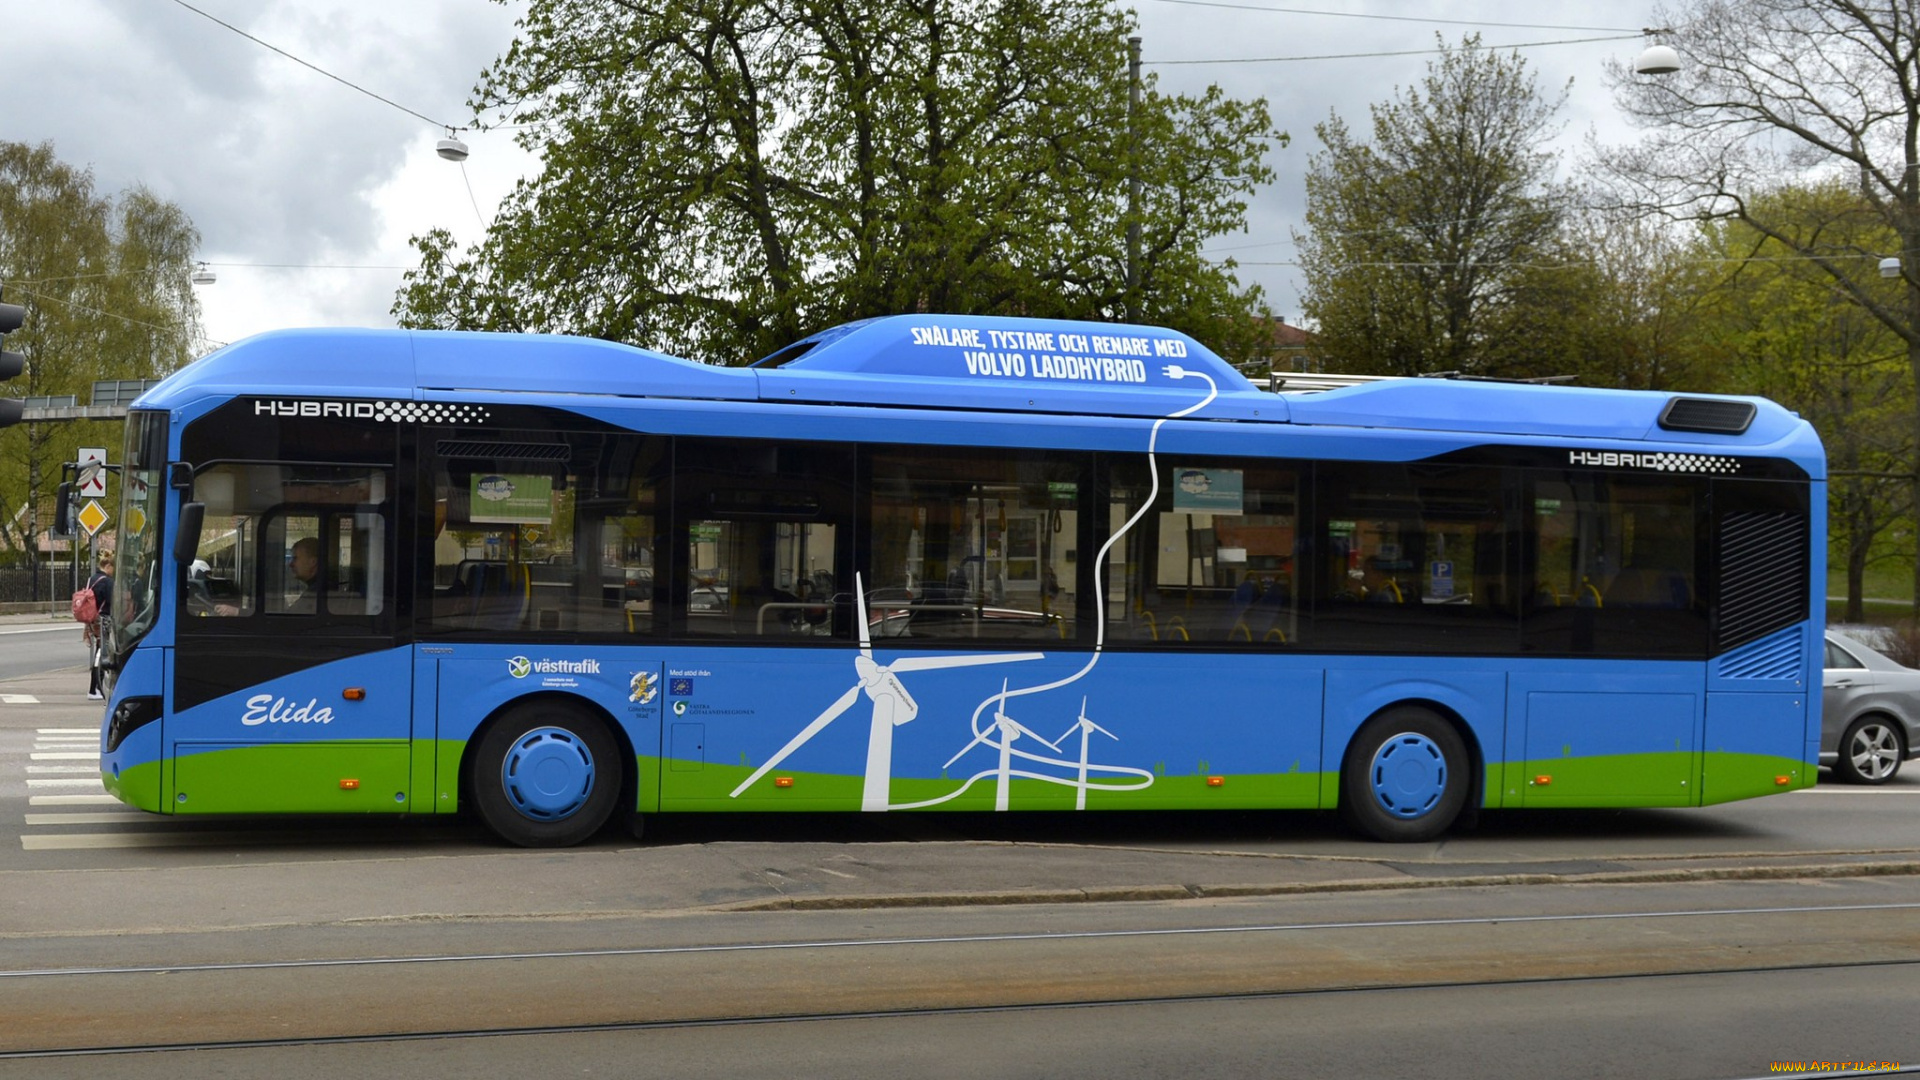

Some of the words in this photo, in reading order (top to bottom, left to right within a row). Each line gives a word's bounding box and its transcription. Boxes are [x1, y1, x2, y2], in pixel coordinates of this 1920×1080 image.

[910, 325, 987, 350] SNÅLARE,
[988, 329, 1056, 352] TYSTARE
[1059, 333, 1089, 353] OCH
[1093, 336, 1151, 357] RENARE
[1154, 339, 1187, 358] MED
[964, 351, 1026, 378] VOLVO
[1030, 354, 1146, 382] LADDHYBRID
[255, 400, 375, 418] HYBRID
[1569, 451, 1657, 468] HYBRID
[1438, 563, 1448, 577] P
[533, 658, 600, 674] västtrafik
[241, 694, 335, 726] Elida
